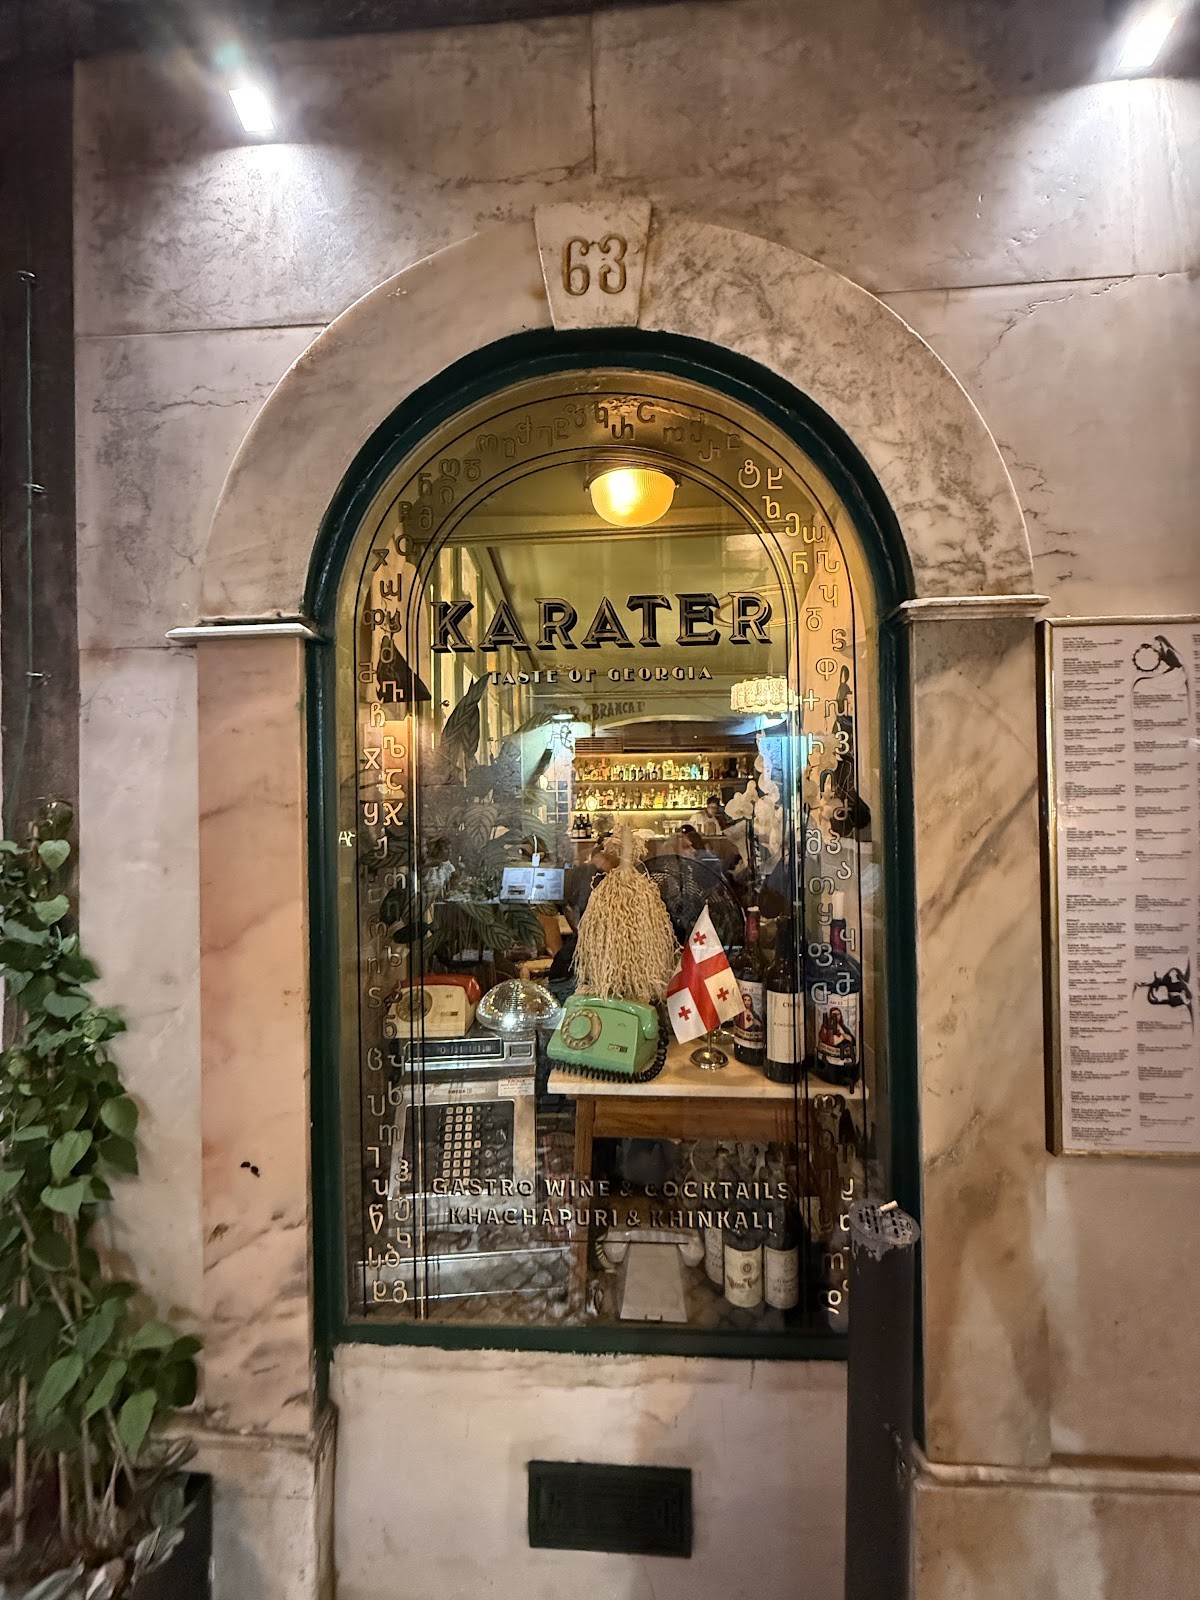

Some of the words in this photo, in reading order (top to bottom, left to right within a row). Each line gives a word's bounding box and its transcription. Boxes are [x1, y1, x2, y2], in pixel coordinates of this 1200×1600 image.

[560, 233, 628, 296] 63
[430, 591, 773, 653] KARATER
[489, 668, 558, 686] TASTE
[568, 668, 597, 683] OF
[607, 666, 713, 683] GEORGIA
[432, 1177, 534, 1197] GASTRO
[544, 1178, 611, 1198] WINE
[644, 1180, 791, 1200] COCKTAILS
[449, 1207, 619, 1228] KHACHAPURI
[626, 1209, 642, 1228] &
[650, 1209, 774, 1230] KHINKALI
